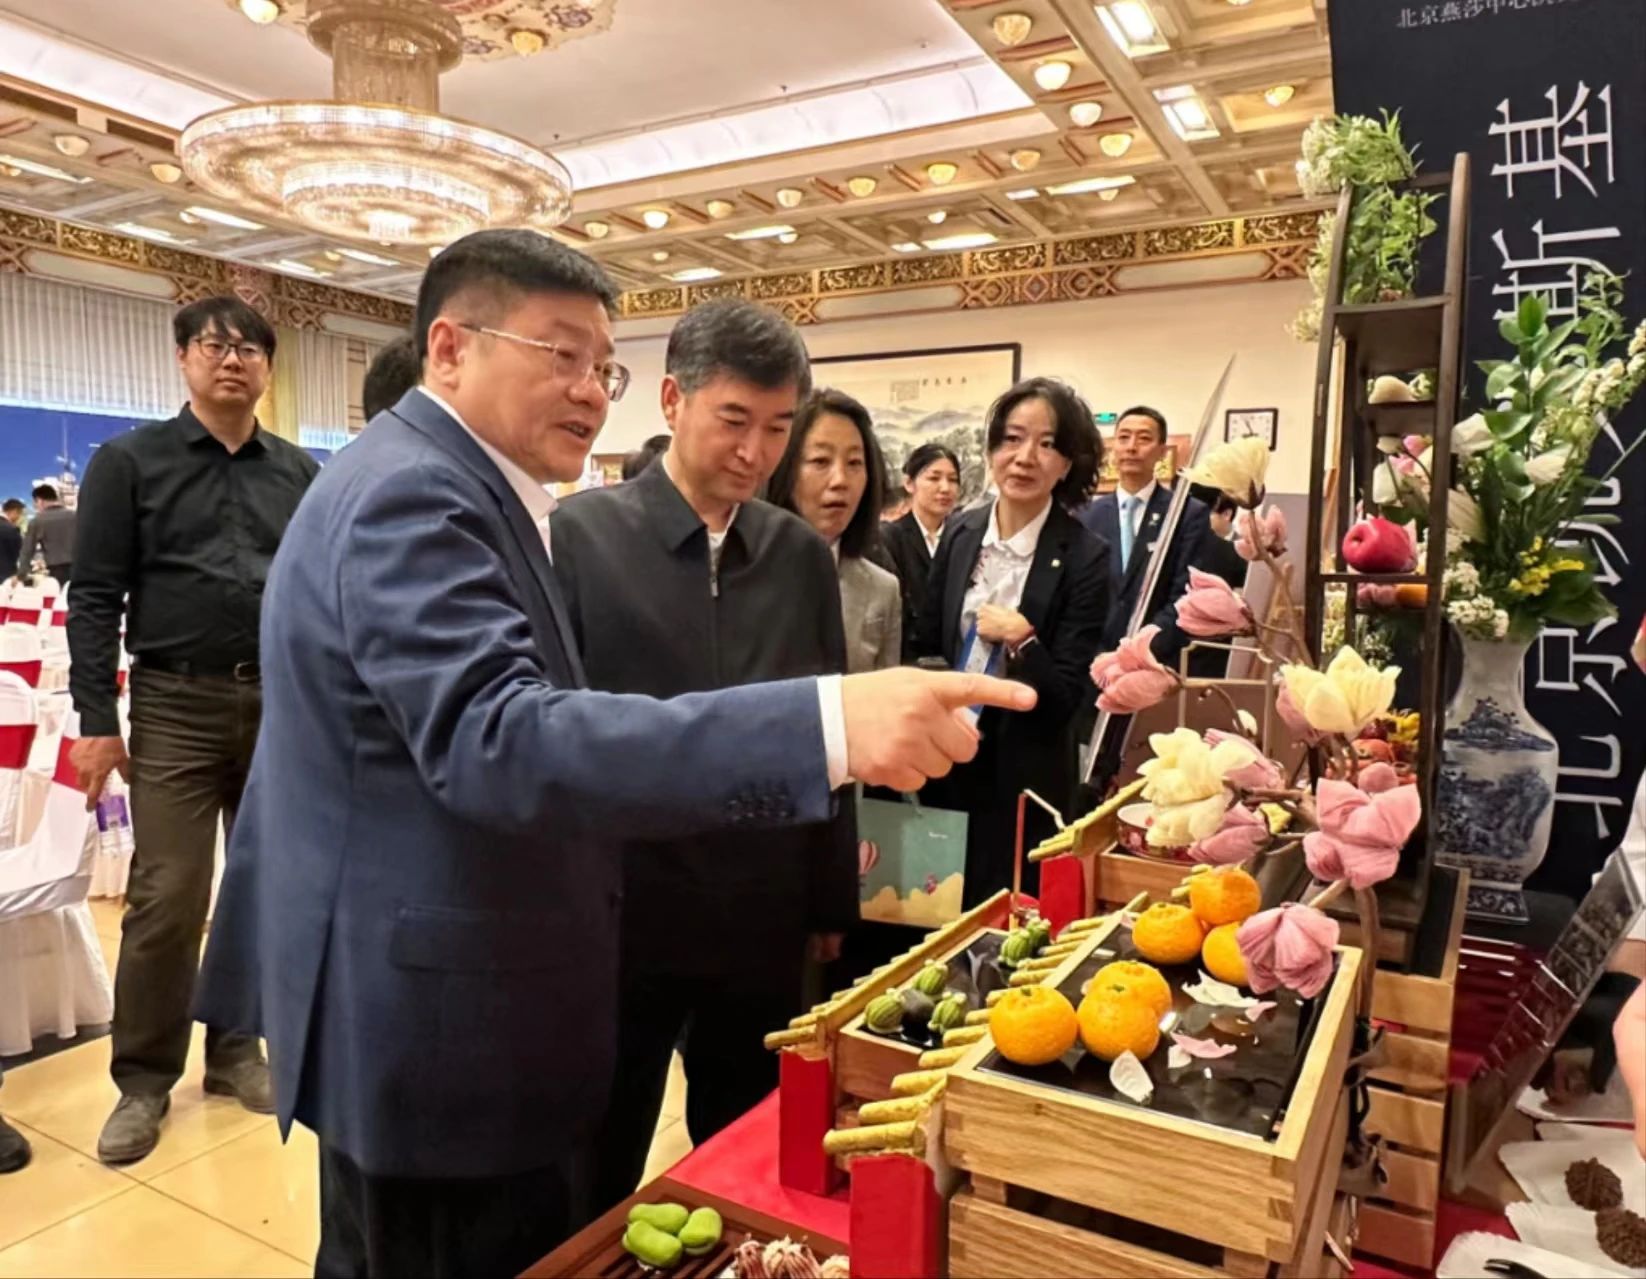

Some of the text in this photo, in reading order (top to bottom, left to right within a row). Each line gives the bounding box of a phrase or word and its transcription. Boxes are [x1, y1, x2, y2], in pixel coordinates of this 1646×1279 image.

[1396, 0, 1562, 28] 北京燕莎中心
[1488, 80, 1629, 838] 北京凯斯基
